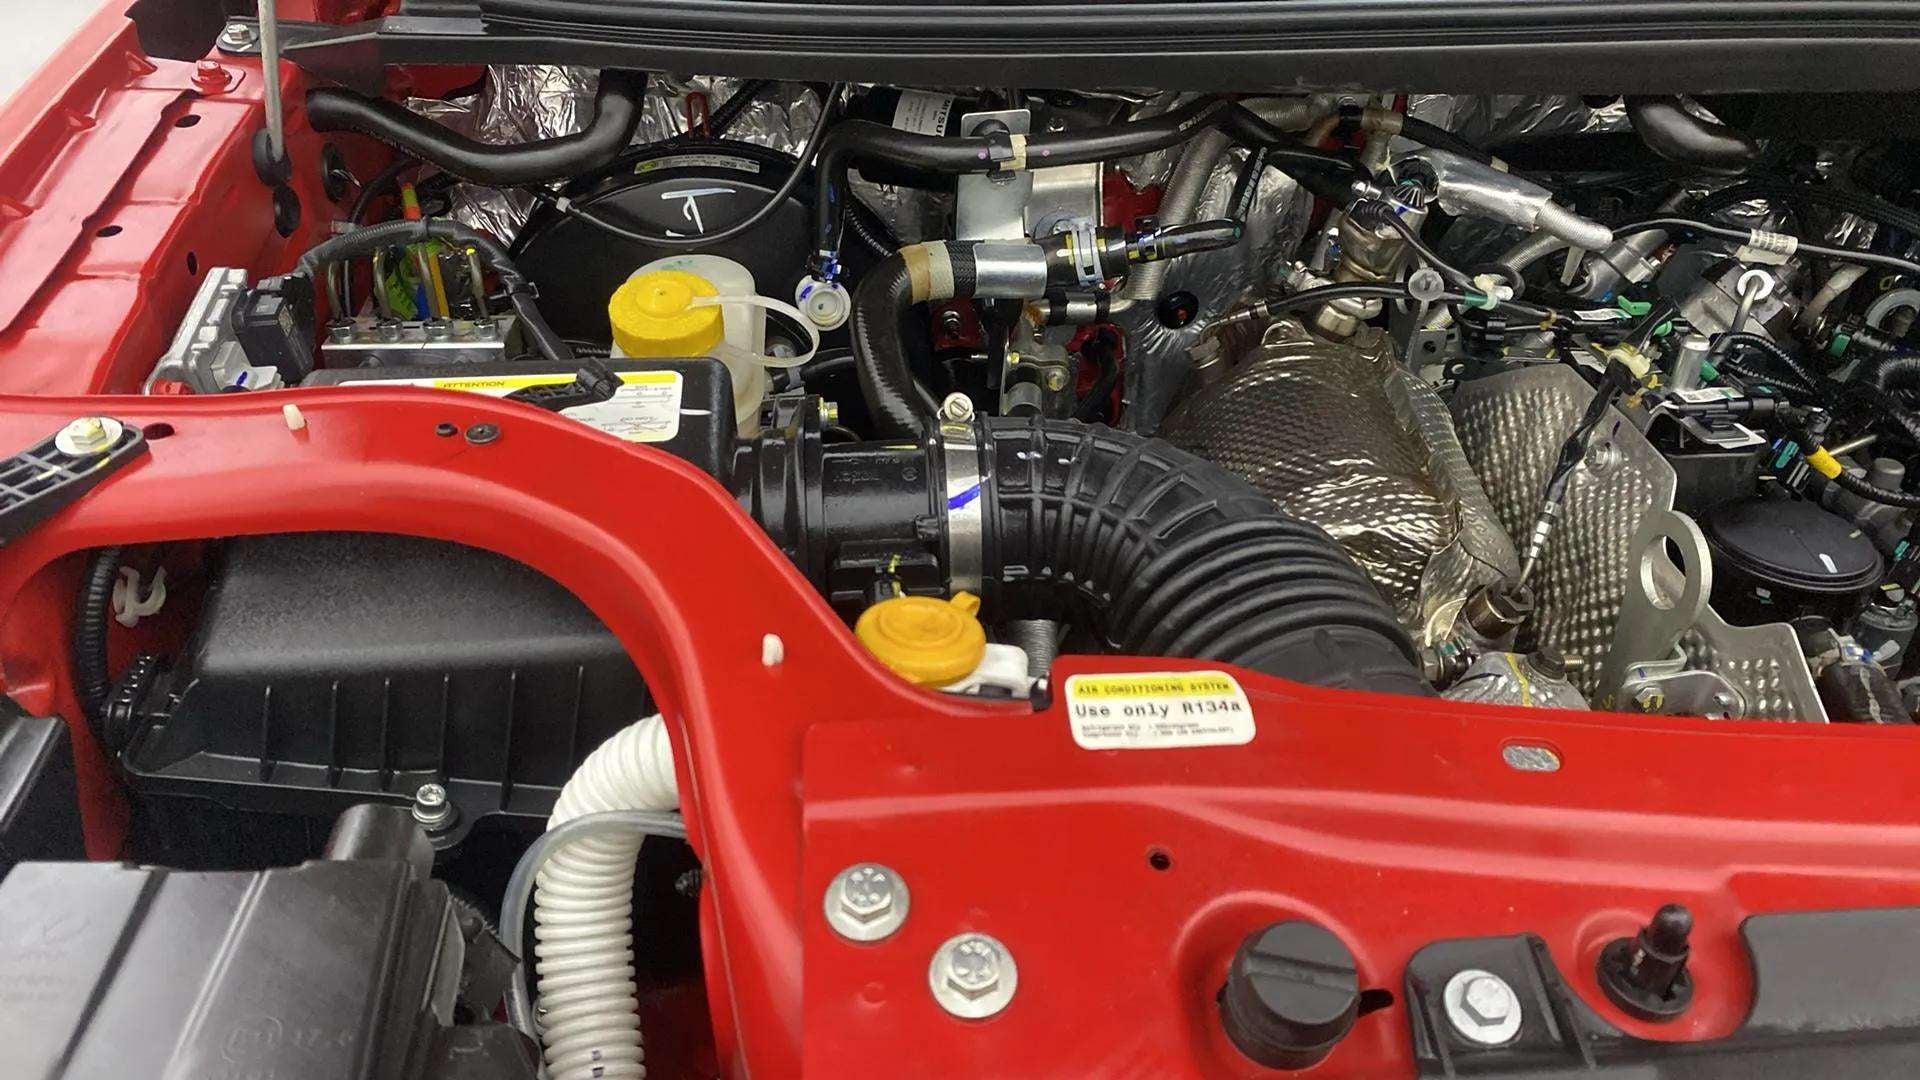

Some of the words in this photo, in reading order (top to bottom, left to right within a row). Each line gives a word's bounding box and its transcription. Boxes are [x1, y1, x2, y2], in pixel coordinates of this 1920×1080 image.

[1078, 684, 1099, 695] AIR
[1103, 682, 1184, 696] CONDITIONING
[1190, 681, 1230, 691] SYSTEM
[1075, 703, 1111, 719] Use
[1123, 702, 1169, 719] only
[1182, 699, 1242, 714] R134a
